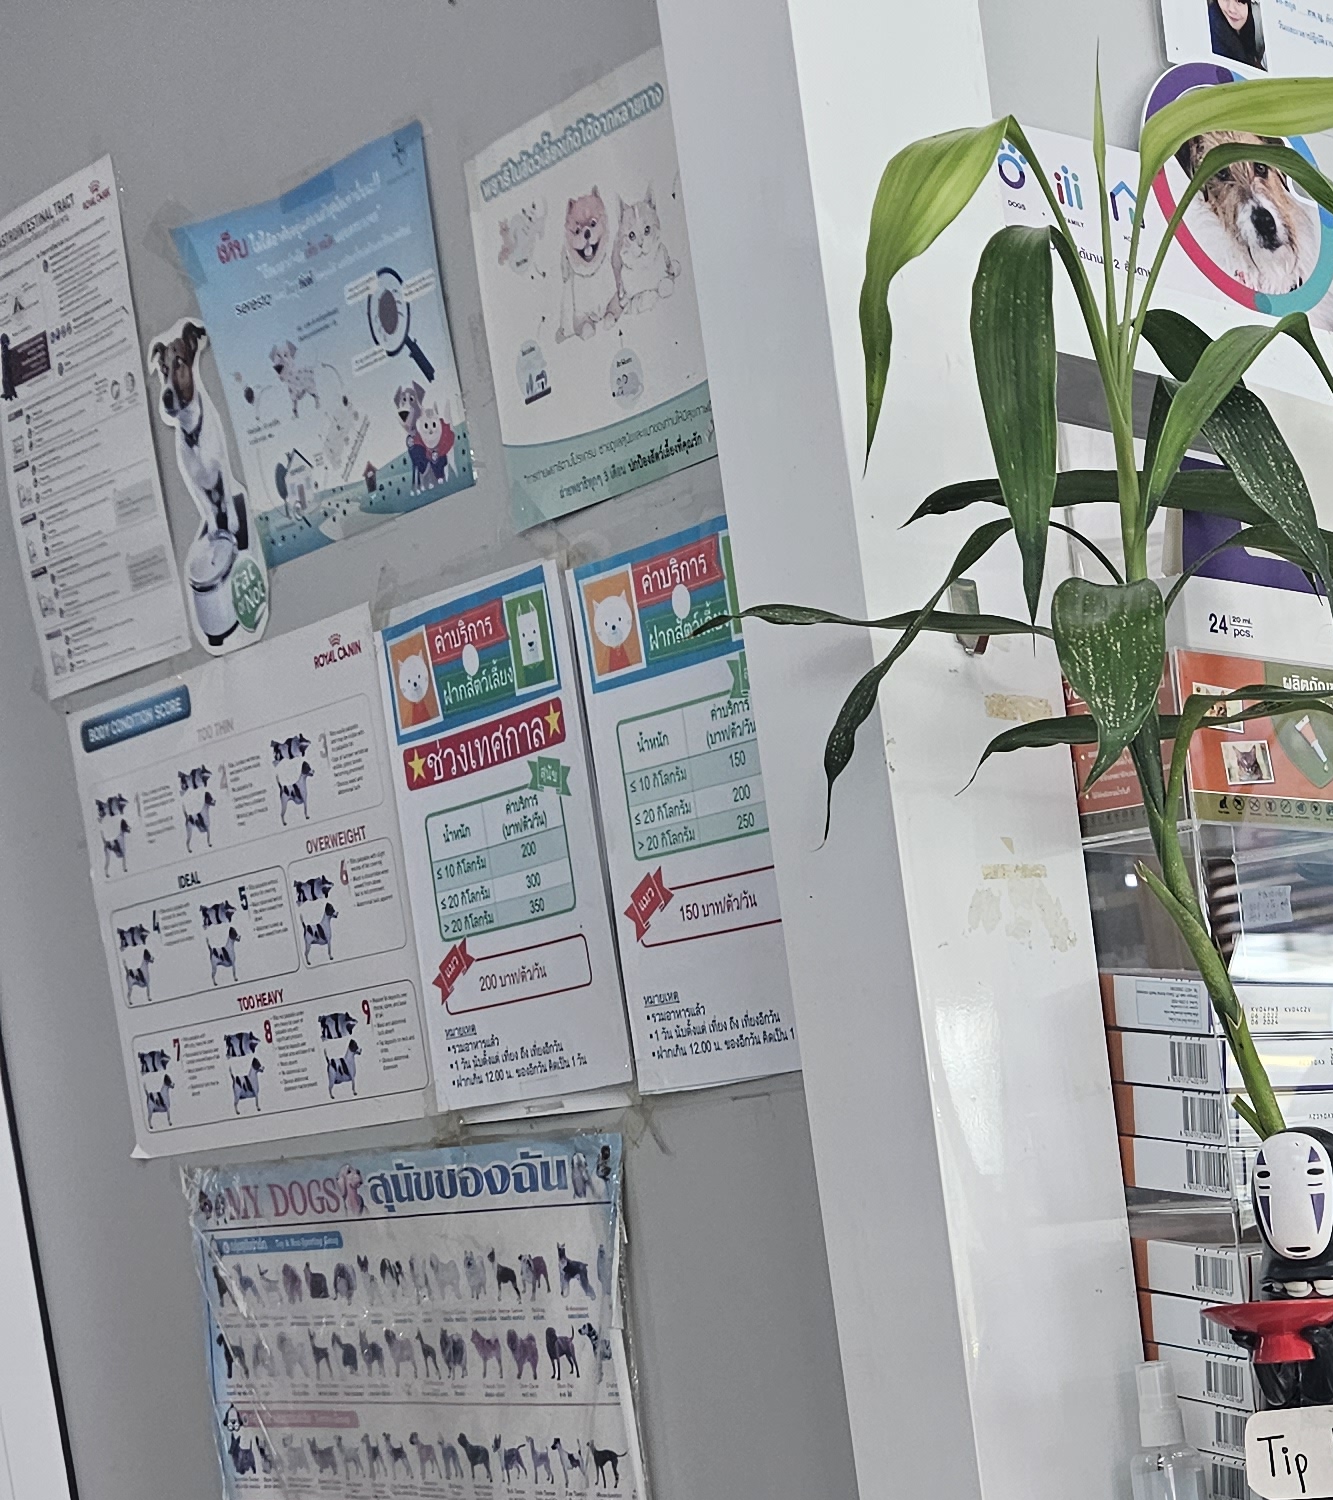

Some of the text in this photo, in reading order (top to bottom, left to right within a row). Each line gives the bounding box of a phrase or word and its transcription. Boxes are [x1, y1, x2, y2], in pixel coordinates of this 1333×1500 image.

[1007, 200, 1026, 211] DOGS
[641, 553, 707, 595] ค่าบริการ
[435, 616, 493, 654] ค่าบริการ
[1209, 613, 1228, 634] 24
[1233, 627, 1254, 639] pcs.
[313, 640, 362, 670] ROYAL CANIN
[443, 659, 514, 706] ฝากสัตว์เลี้ยง
[637, 698, 750, 753] น้ำหนัก ค่าบริการ
[427, 716, 546, 781] ช่วงเทศกาล
[639, 750, 746, 791] 10 กิโลกรัม 150
[443, 794, 538, 843] น้ำหนัก ค่าบริการ
[643, 784, 750, 824] 20 กิโลกรัม 200
[306, 825, 366, 854] OVERWEIGHT
[647, 812, 755, 851] 20 กิโลกรัม 250
[340, 859, 349, 886] 6
[444, 841, 537, 879] 10 กิโลกรัม 200
[178, 871, 201, 889] IDEAL
[448, 872, 541, 910] 20 กิโลกรัม 300
[238, 886, 248, 910] 5
[638, 887, 655, 911] แมว
[679, 890, 757, 921] 150 บาท/ตัว/วัน
[451, 897, 545, 934] 20 กิโลกรัม 350
[445, 955, 459, 978] แมว
[479, 974, 497, 991] 200
[237, 989, 284, 1012] TOO HEAVY
[362, 1000, 371, 1025] 9
[264, 1019, 273, 1043] 8
[172, 1038, 181, 1062] 7
[689, 1039, 712, 1055] 12.00
[485, 1069, 504, 1083] 12.00
[272, 1178, 341, 1217] DOGS
[367, 1150, 568, 1211] สุนัขของฉัน
[1257, 1433, 1309, 1493] Tip
